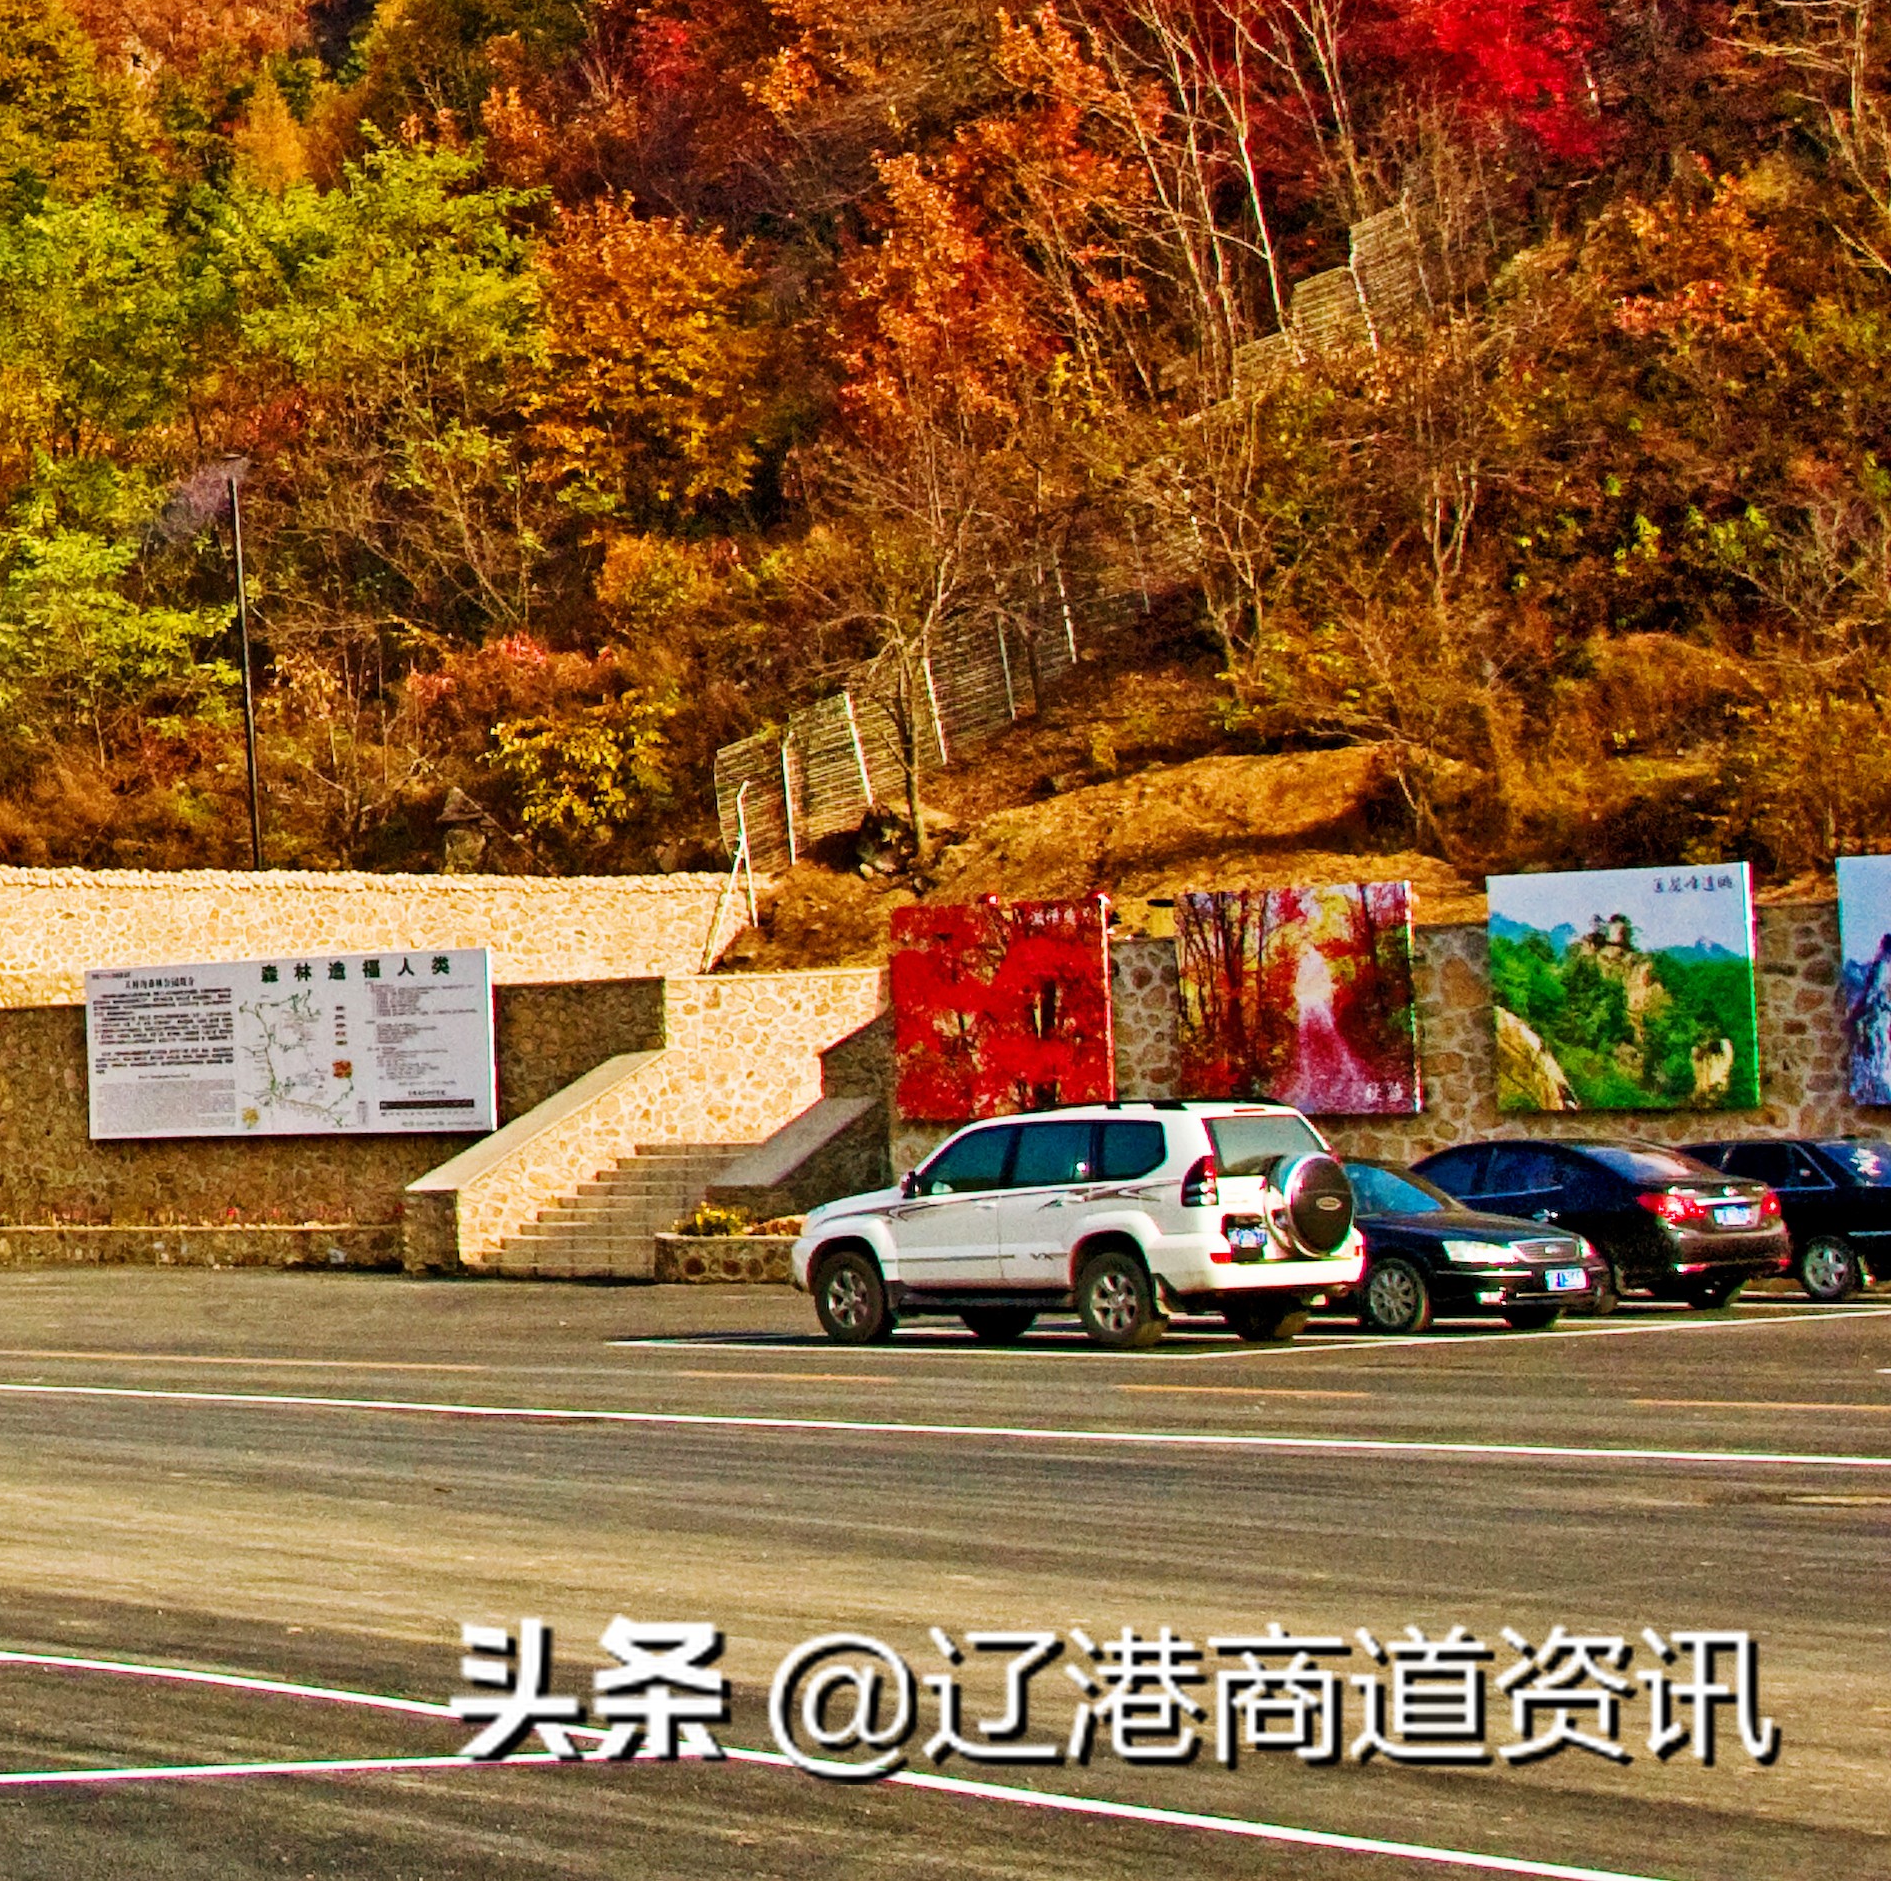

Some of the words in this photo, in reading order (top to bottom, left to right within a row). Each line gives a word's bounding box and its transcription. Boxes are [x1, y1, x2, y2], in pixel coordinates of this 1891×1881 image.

[261, 955, 450, 984] 森林造福人类
